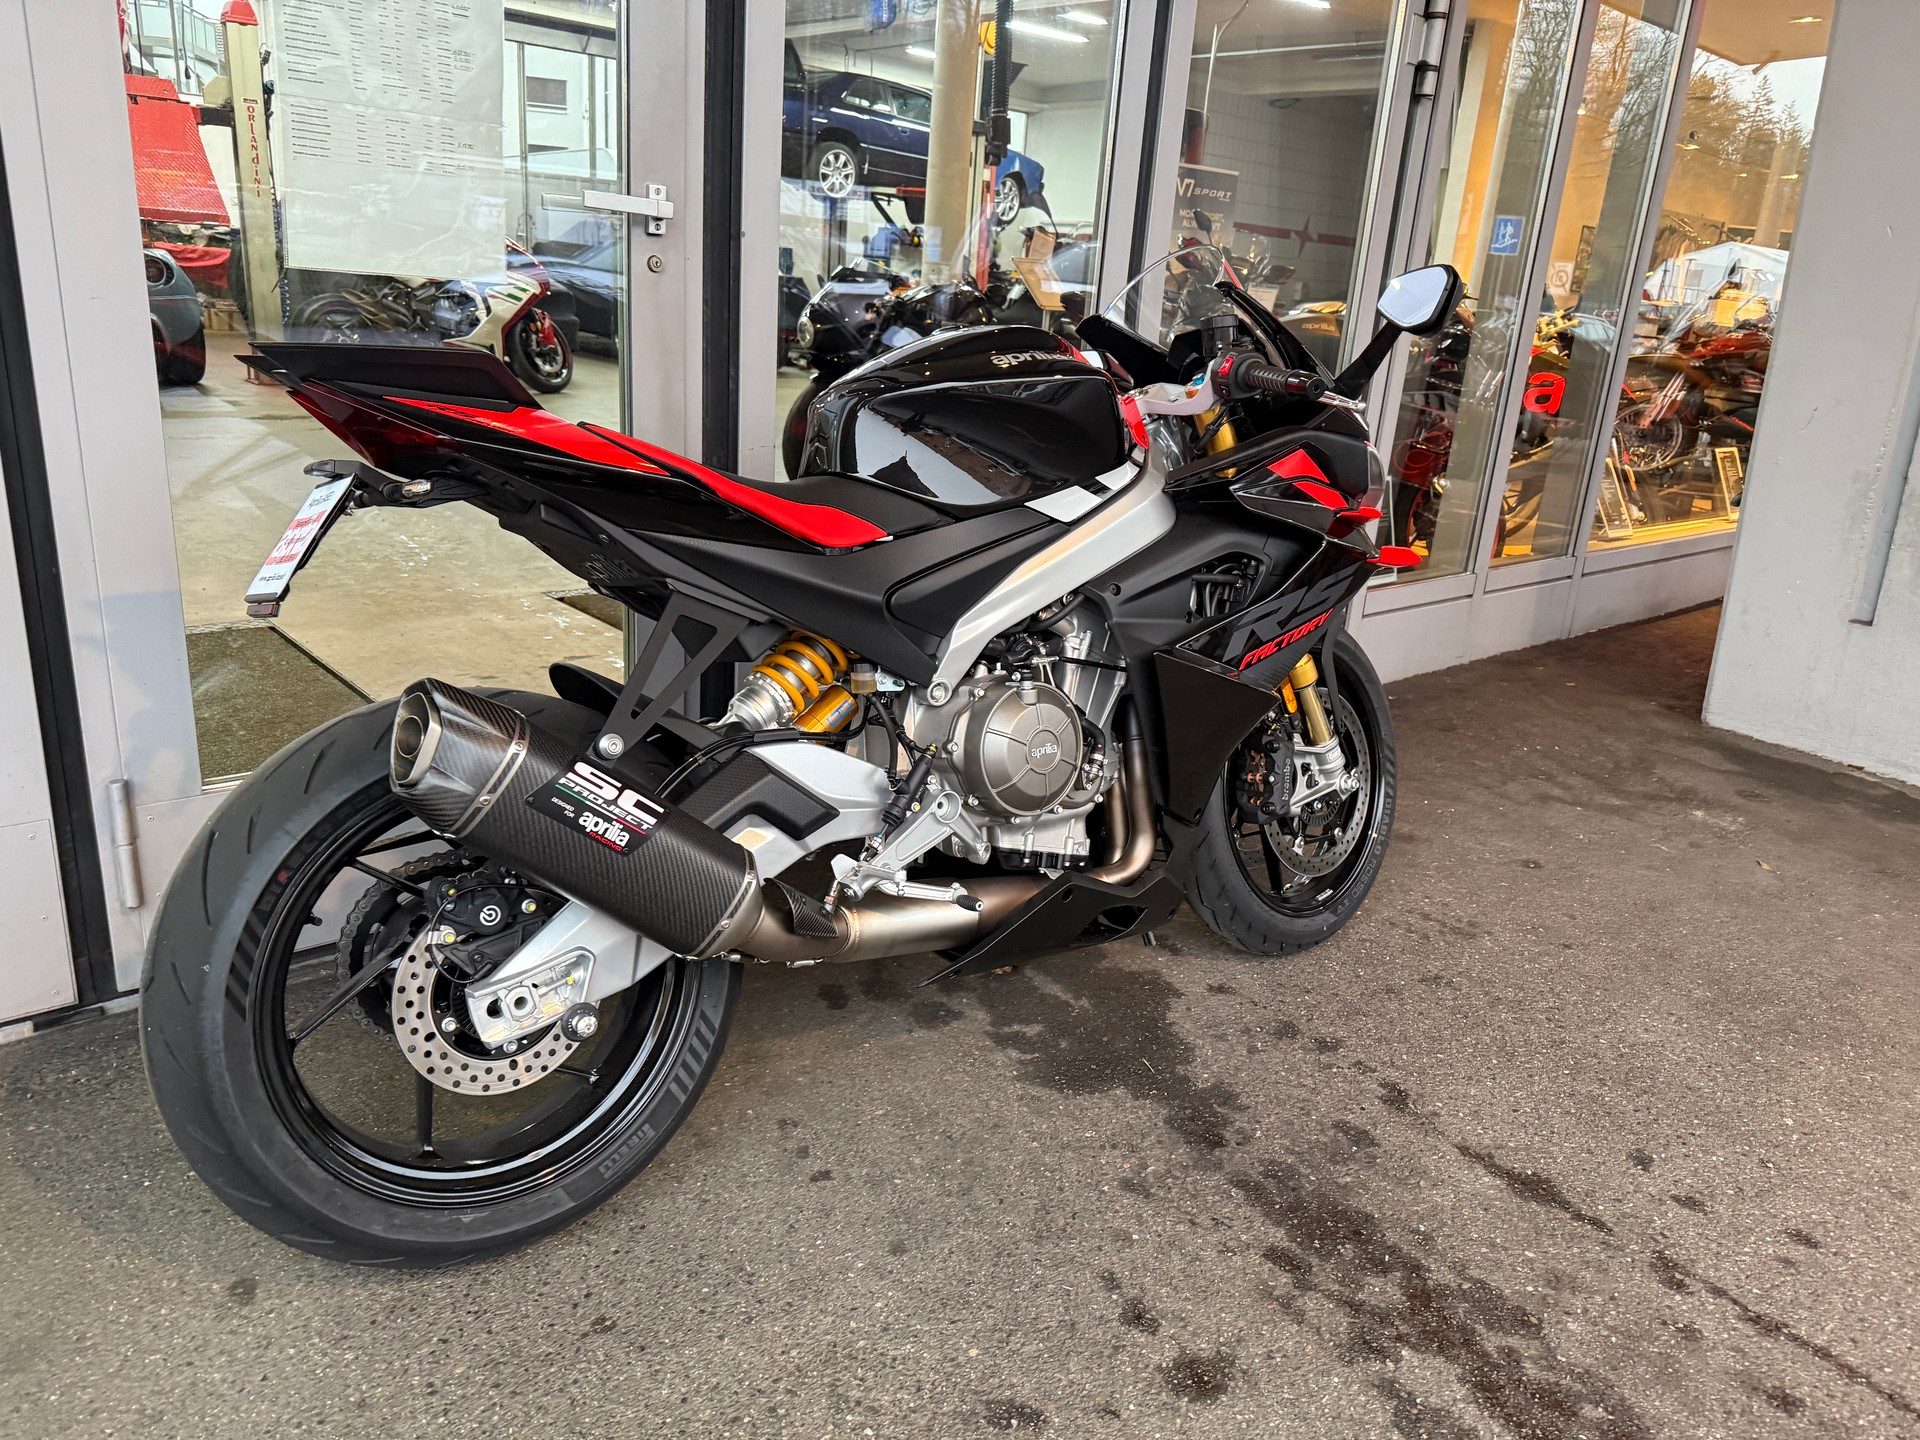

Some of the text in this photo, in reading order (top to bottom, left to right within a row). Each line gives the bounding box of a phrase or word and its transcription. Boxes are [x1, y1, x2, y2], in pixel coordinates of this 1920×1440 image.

[1193, 187, 1232, 199] SPORT
[1302, 323, 1335, 331] aprilia
[1222, 560, 1364, 663] RS
[1239, 608, 1334, 671] FACTORY
[565, 761, 665, 826] SC
[1282, 758, 1292, 801] brembo
[550, 796, 575, 813] DESIGNED
[557, 777, 653, 831] PROJECT
[563, 809, 576, 819] FOR
[578, 811, 631, 848] aprilia
[588, 831, 623, 852] RACING
[1374, 798, 1393, 855] DIABLO
[1351, 859, 1377, 898] ROSSO
